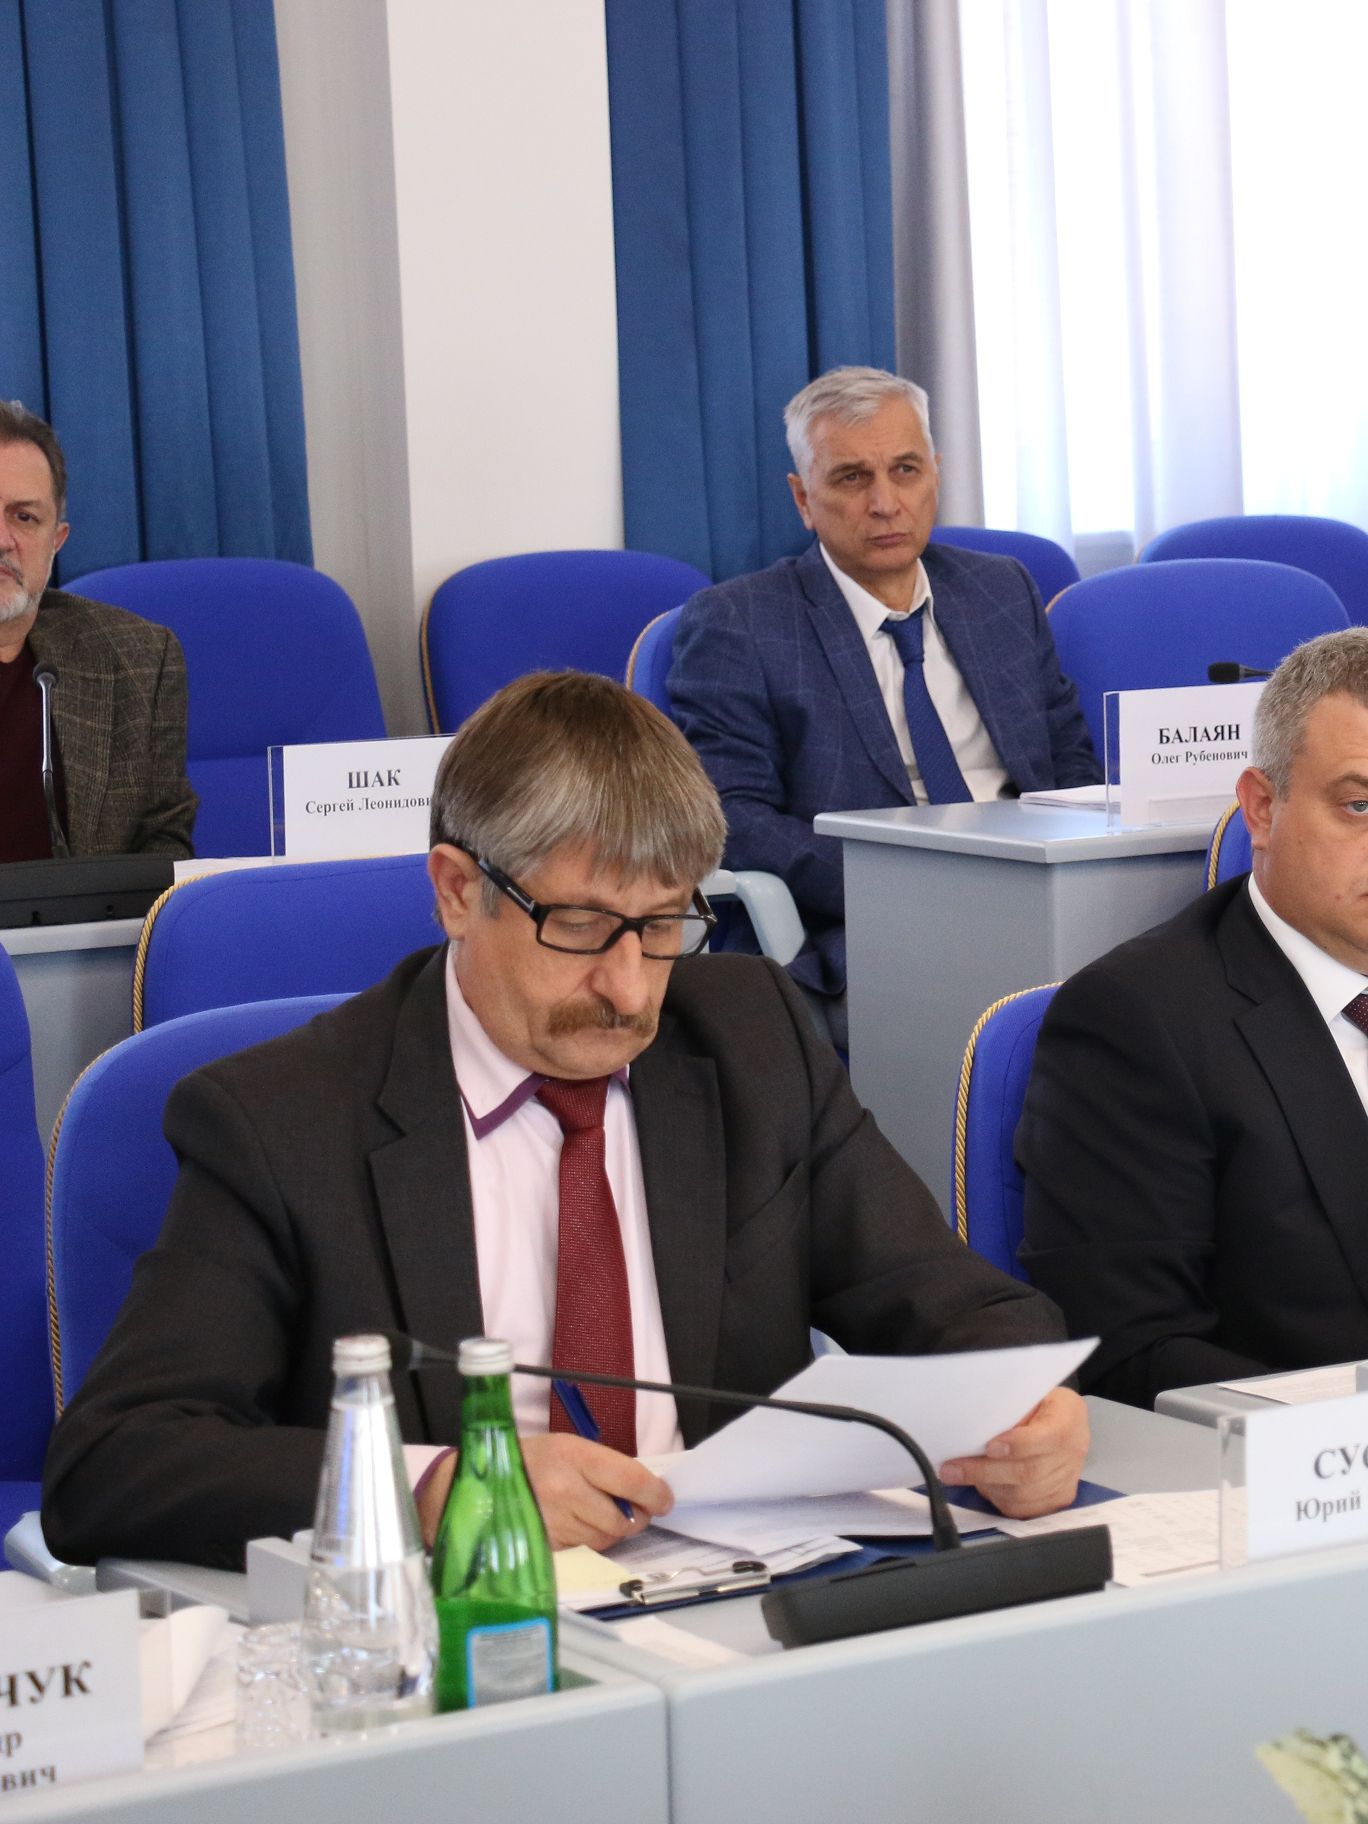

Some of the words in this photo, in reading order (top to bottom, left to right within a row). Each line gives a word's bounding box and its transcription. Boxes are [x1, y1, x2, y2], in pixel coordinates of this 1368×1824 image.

[1158, 723, 1241, 745] БАЛАЯН
[1151, 752, 1181, 765] Олег
[1185, 750, 1249, 766] Рубенович
[347, 768, 401, 789] ШАК
[305, 799, 354, 816] Сергей
[1295, 1490, 1362, 1523] Юрий
